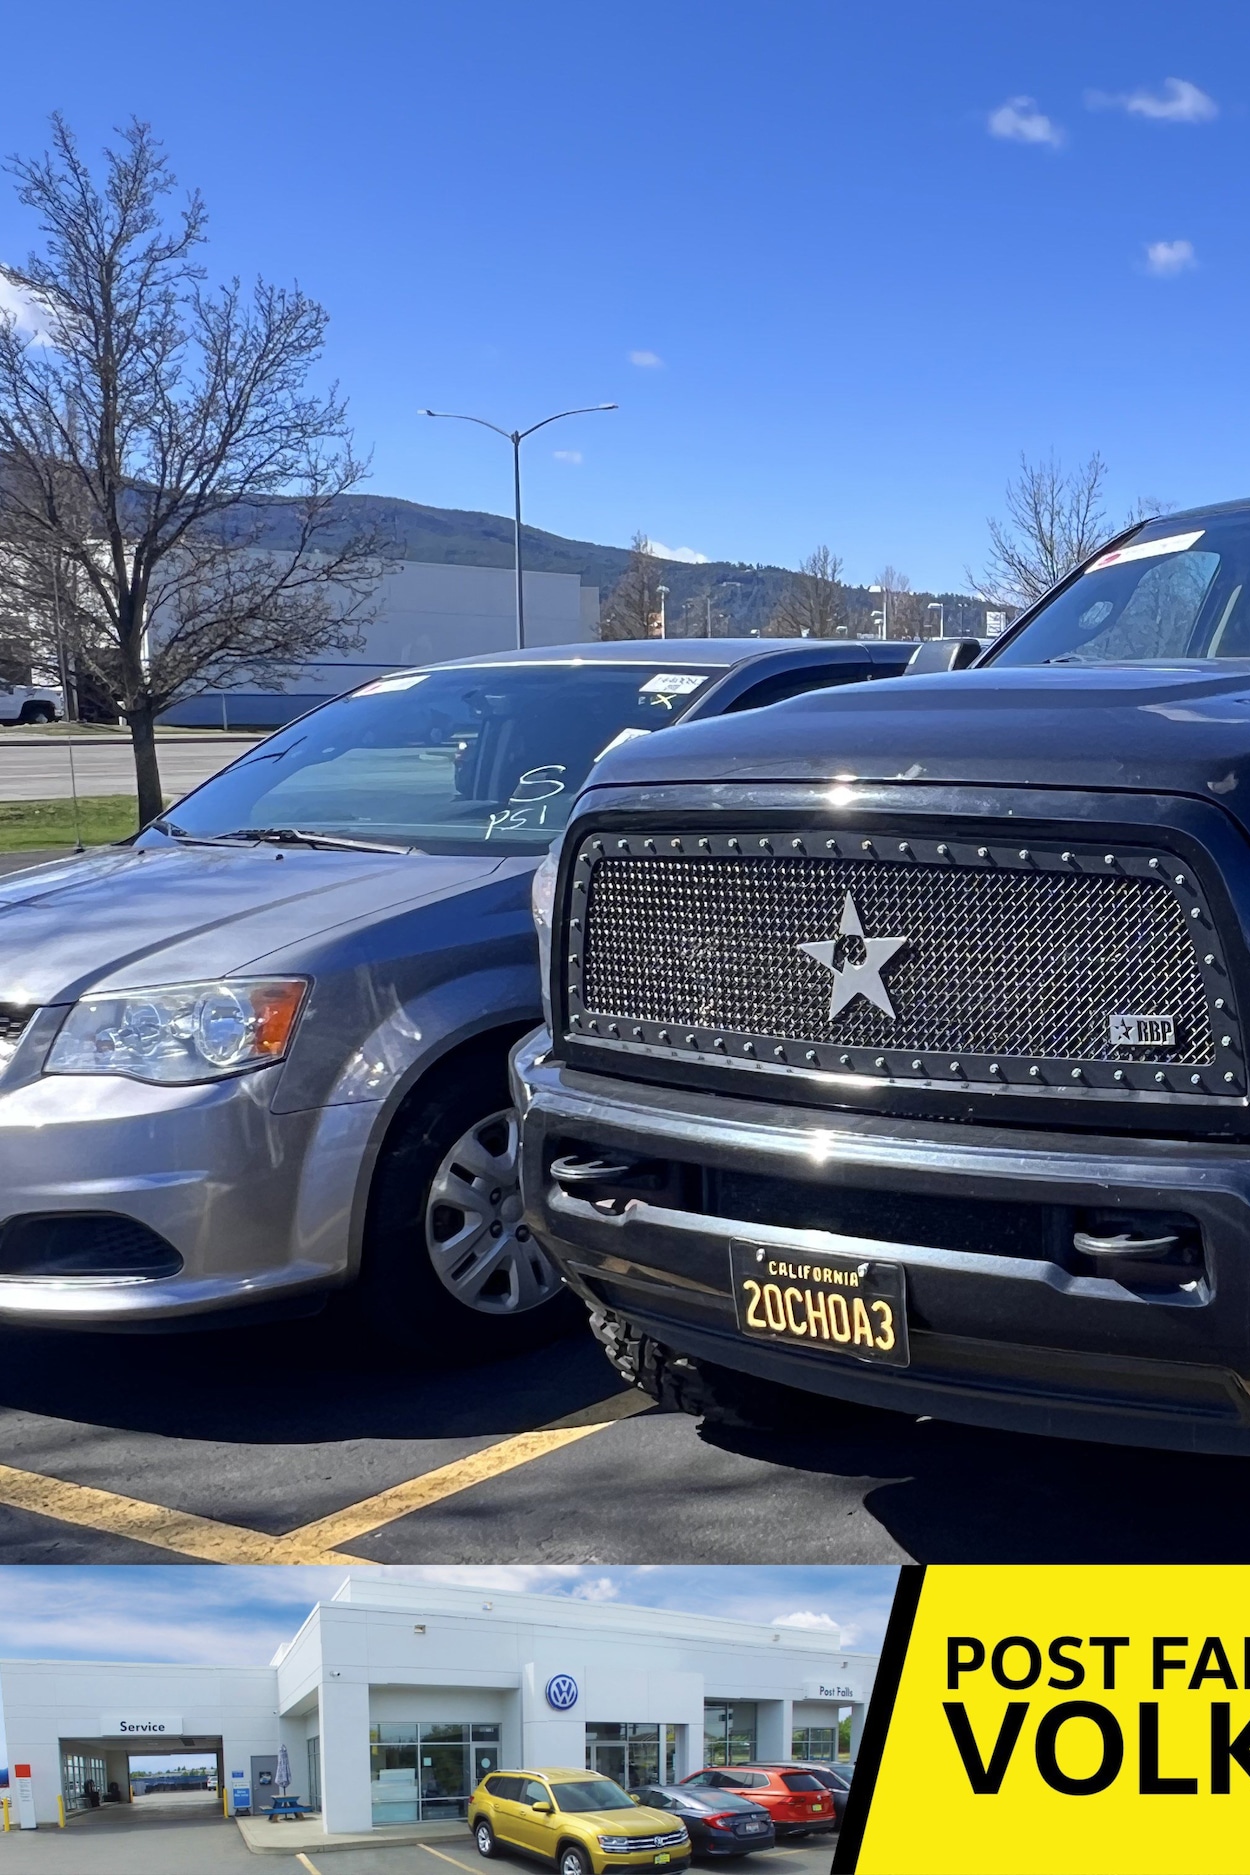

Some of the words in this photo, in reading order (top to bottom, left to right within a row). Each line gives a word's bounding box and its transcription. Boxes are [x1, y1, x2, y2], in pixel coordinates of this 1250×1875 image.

[509, 765, 567, 802] S
[1137, 1020, 1172, 1042] RBP
[768, 1260, 859, 1287] CALIFORNIA
